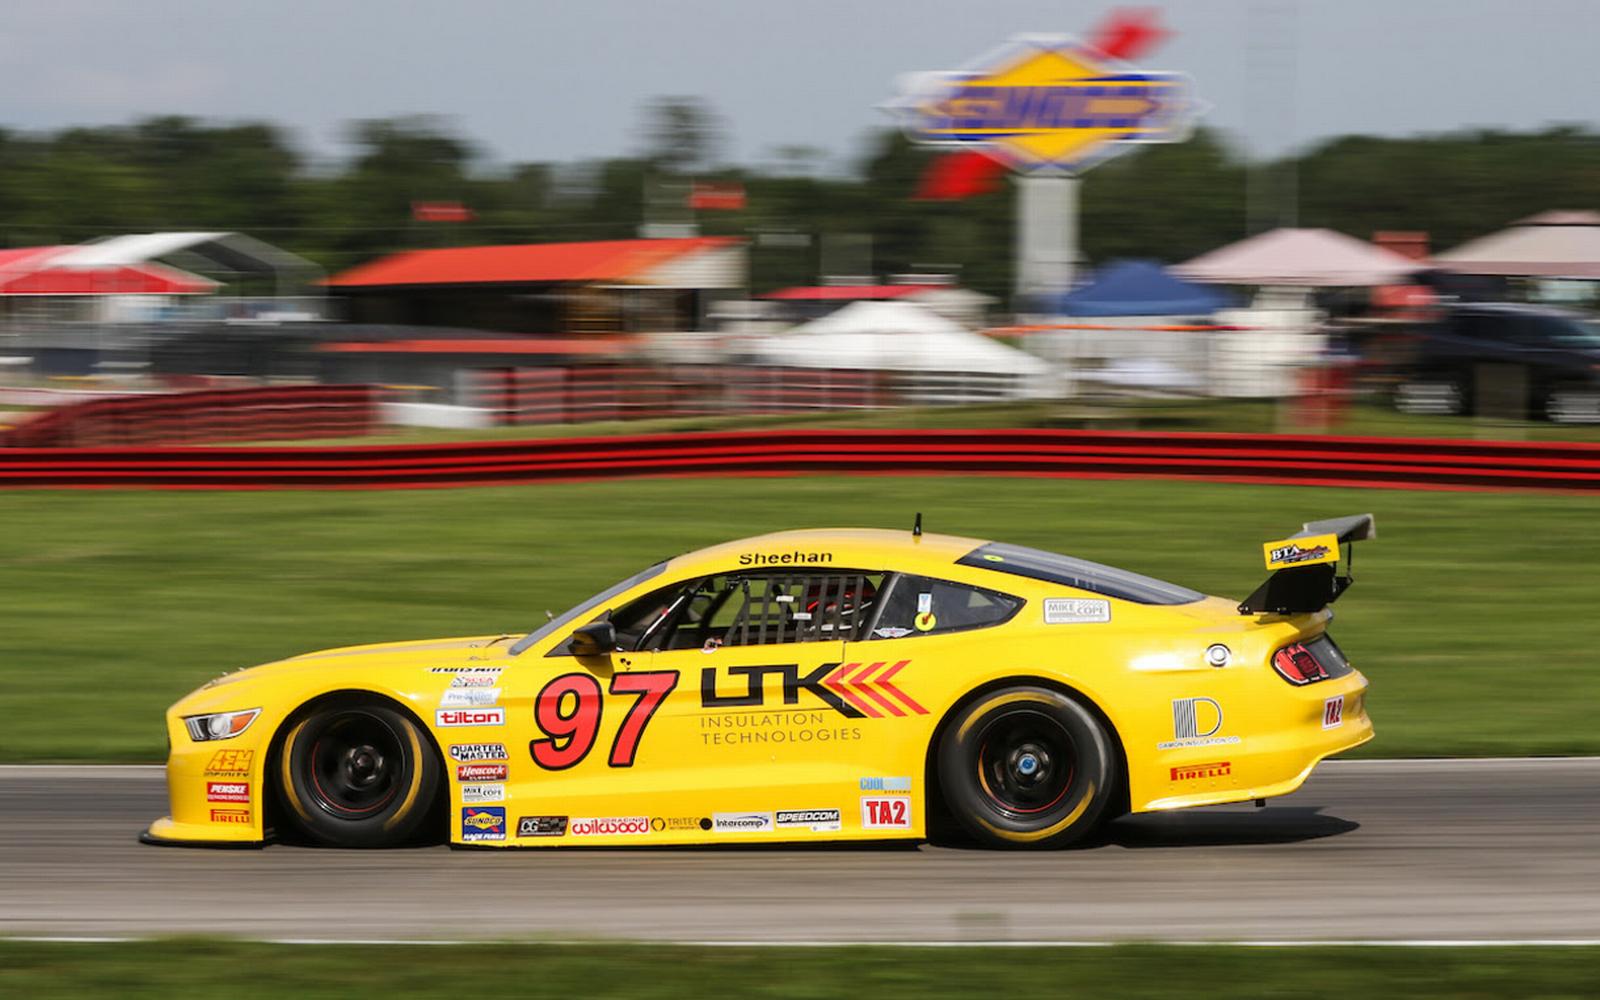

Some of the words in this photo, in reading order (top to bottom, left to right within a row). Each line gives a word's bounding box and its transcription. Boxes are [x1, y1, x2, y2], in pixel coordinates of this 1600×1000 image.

[739, 551, 833, 566] Sheehan
[1271, 544, 1300, 561] BTA
[1048, 603, 1074, 611] MIKE
[441, 711, 500, 724] tilton
[529, 672, 680, 771] 97
[701, 713, 824, 728] INSULATION
[701, 728, 862, 745] TECHNOLOGIES
[450, 744, 503, 757] QUARTER
[460, 752, 506, 761] MASTER
[462, 765, 505, 776] Heacock
[1170, 762, 1232, 781] PIRELLI
[210, 809, 250, 823] PIRELLI
[778, 811, 838, 822] SPEEDCOM
[866, 800, 906, 825] TA2
[466, 817, 502, 825] SUNOCO
[572, 817, 649, 834] wilwood
[716, 818, 764, 830] Intercomp
